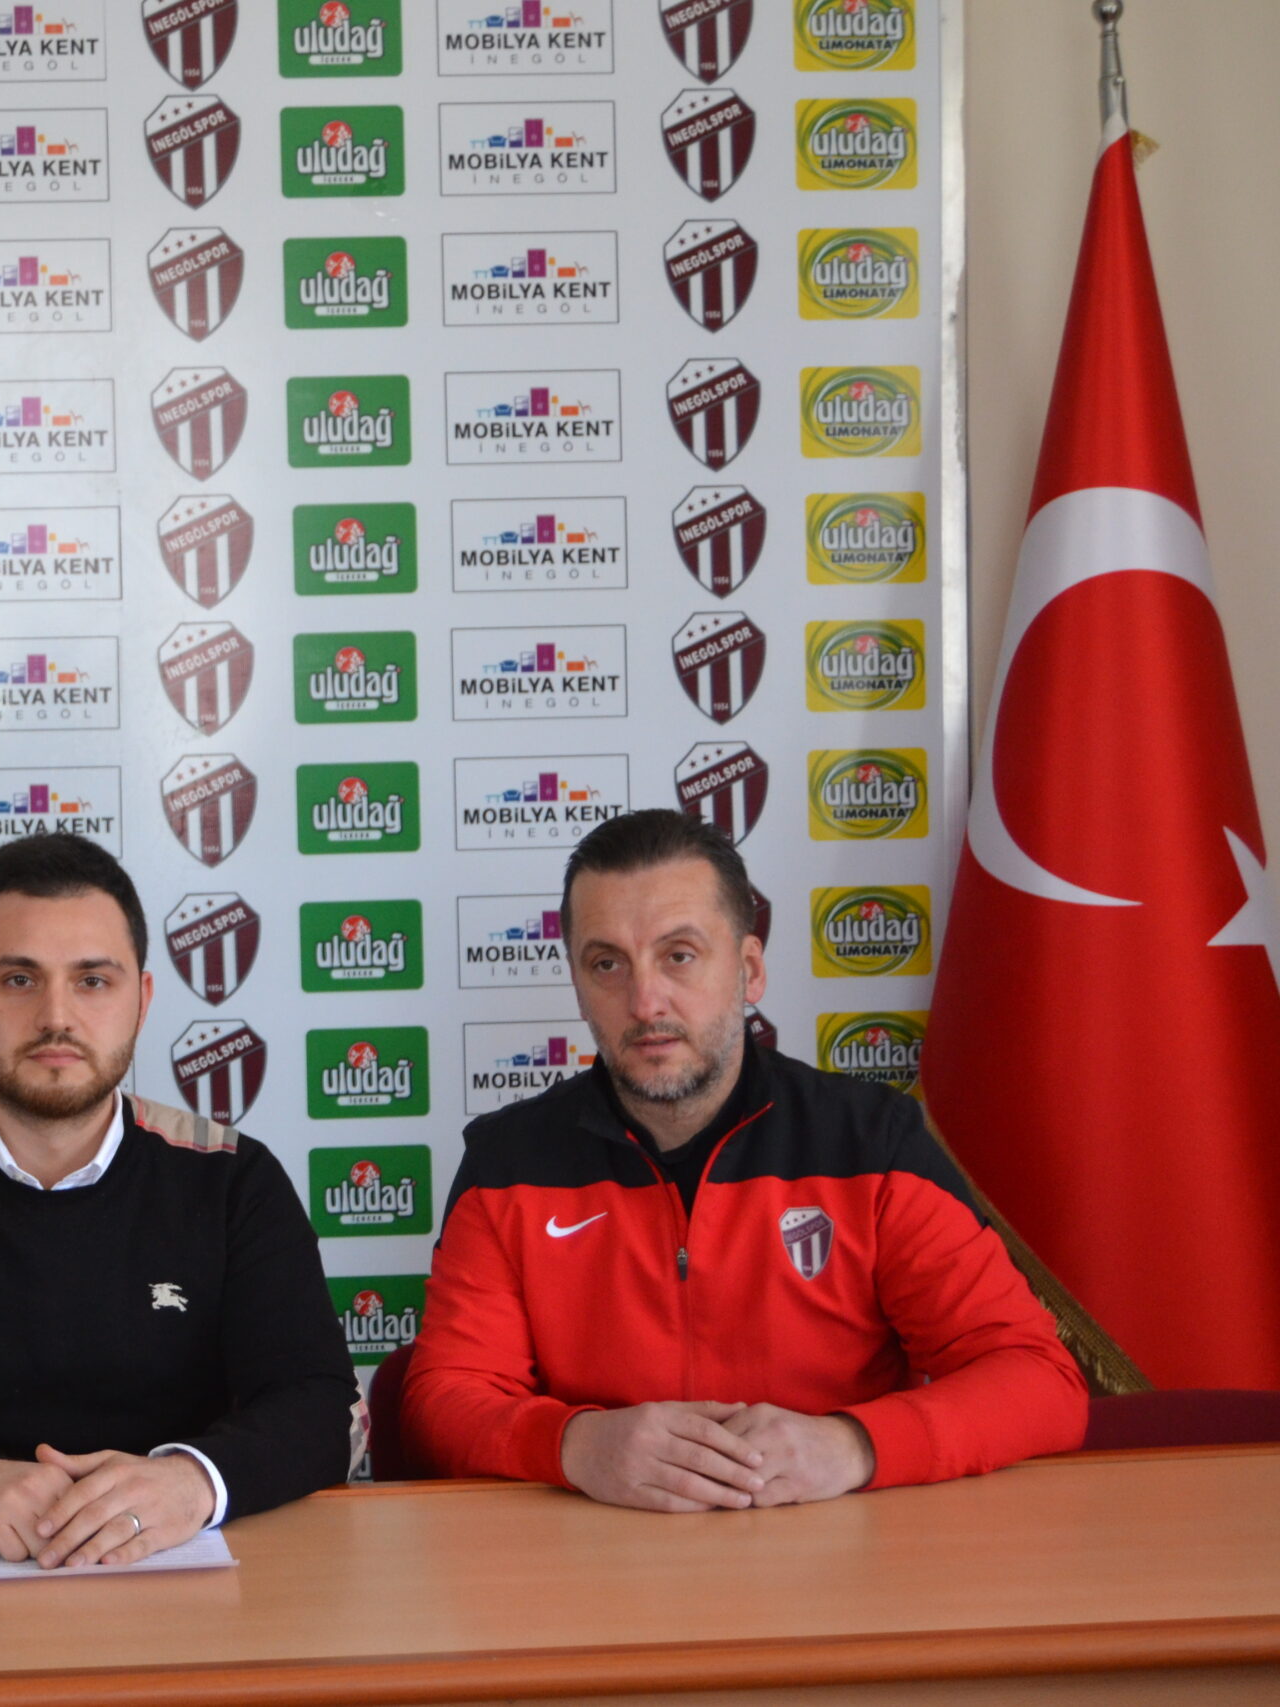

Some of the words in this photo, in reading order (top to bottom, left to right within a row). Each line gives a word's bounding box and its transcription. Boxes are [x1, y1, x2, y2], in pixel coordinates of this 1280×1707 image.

[40, 38, 100, 56] KENT
[294, 18, 383, 58] uludağ
[549, 31, 606, 48] KENT
[151, 109, 228, 154] İNEGÖLSPOR
[666, 103, 742, 147] İNEGÖLSPOR
[42, 159, 102, 177] KENT
[297, 138, 386, 178] uludağ
[551, 151, 608, 168] KENT
[154, 241, 231, 286] İNEGÖLSPOR
[668, 234, 744, 278] İNEGÖLSPOR
[45, 289, 105, 307] KENT
[300, 269, 389, 309] uludağ
[554, 281, 611, 298] KENT
[158, 381, 235, 426] İNEGÖLSPOR
[671, 373, 747, 417] İNEGÖLSPOR
[47, 430, 107, 448] KENT
[303, 408, 392, 448] uludağ
[557, 420, 614, 437] KENT
[164, 509, 241, 554] İNEGÖLSPOR
[677, 500, 753, 544] İNEGÖLSPOR
[53, 558, 113, 576] KENT
[310, 535, 399, 575] uludağ
[563, 547, 620, 564] KENT
[164, 636, 241, 681] İNEGÖLSPOR
[677, 626, 753, 670] İNEGÖLSPOR
[53, 687, 113, 705] KENT
[310, 664, 399, 704] uludağ
[563, 675, 620, 692] KENT
[168, 768, 245, 813] İNEGÖLSPOR
[679, 756, 755, 800] İNEGÖLSPOR
[56, 817, 114, 834] KENT
[313, 794, 402, 834] uludağ
[488, 826, 582, 839] İNEGÖ
[171, 907, 248, 952] İNEGÖLSPOR
[316, 932, 405, 972] uludağ
[491, 965, 562, 977] İNEG
[177, 1034, 254, 1079] İNEGÖLSPOR
[322, 1059, 411, 1099] uludağ
[325, 1178, 414, 1218] uludağ
[339, 1307, 417, 1345] ludağ
